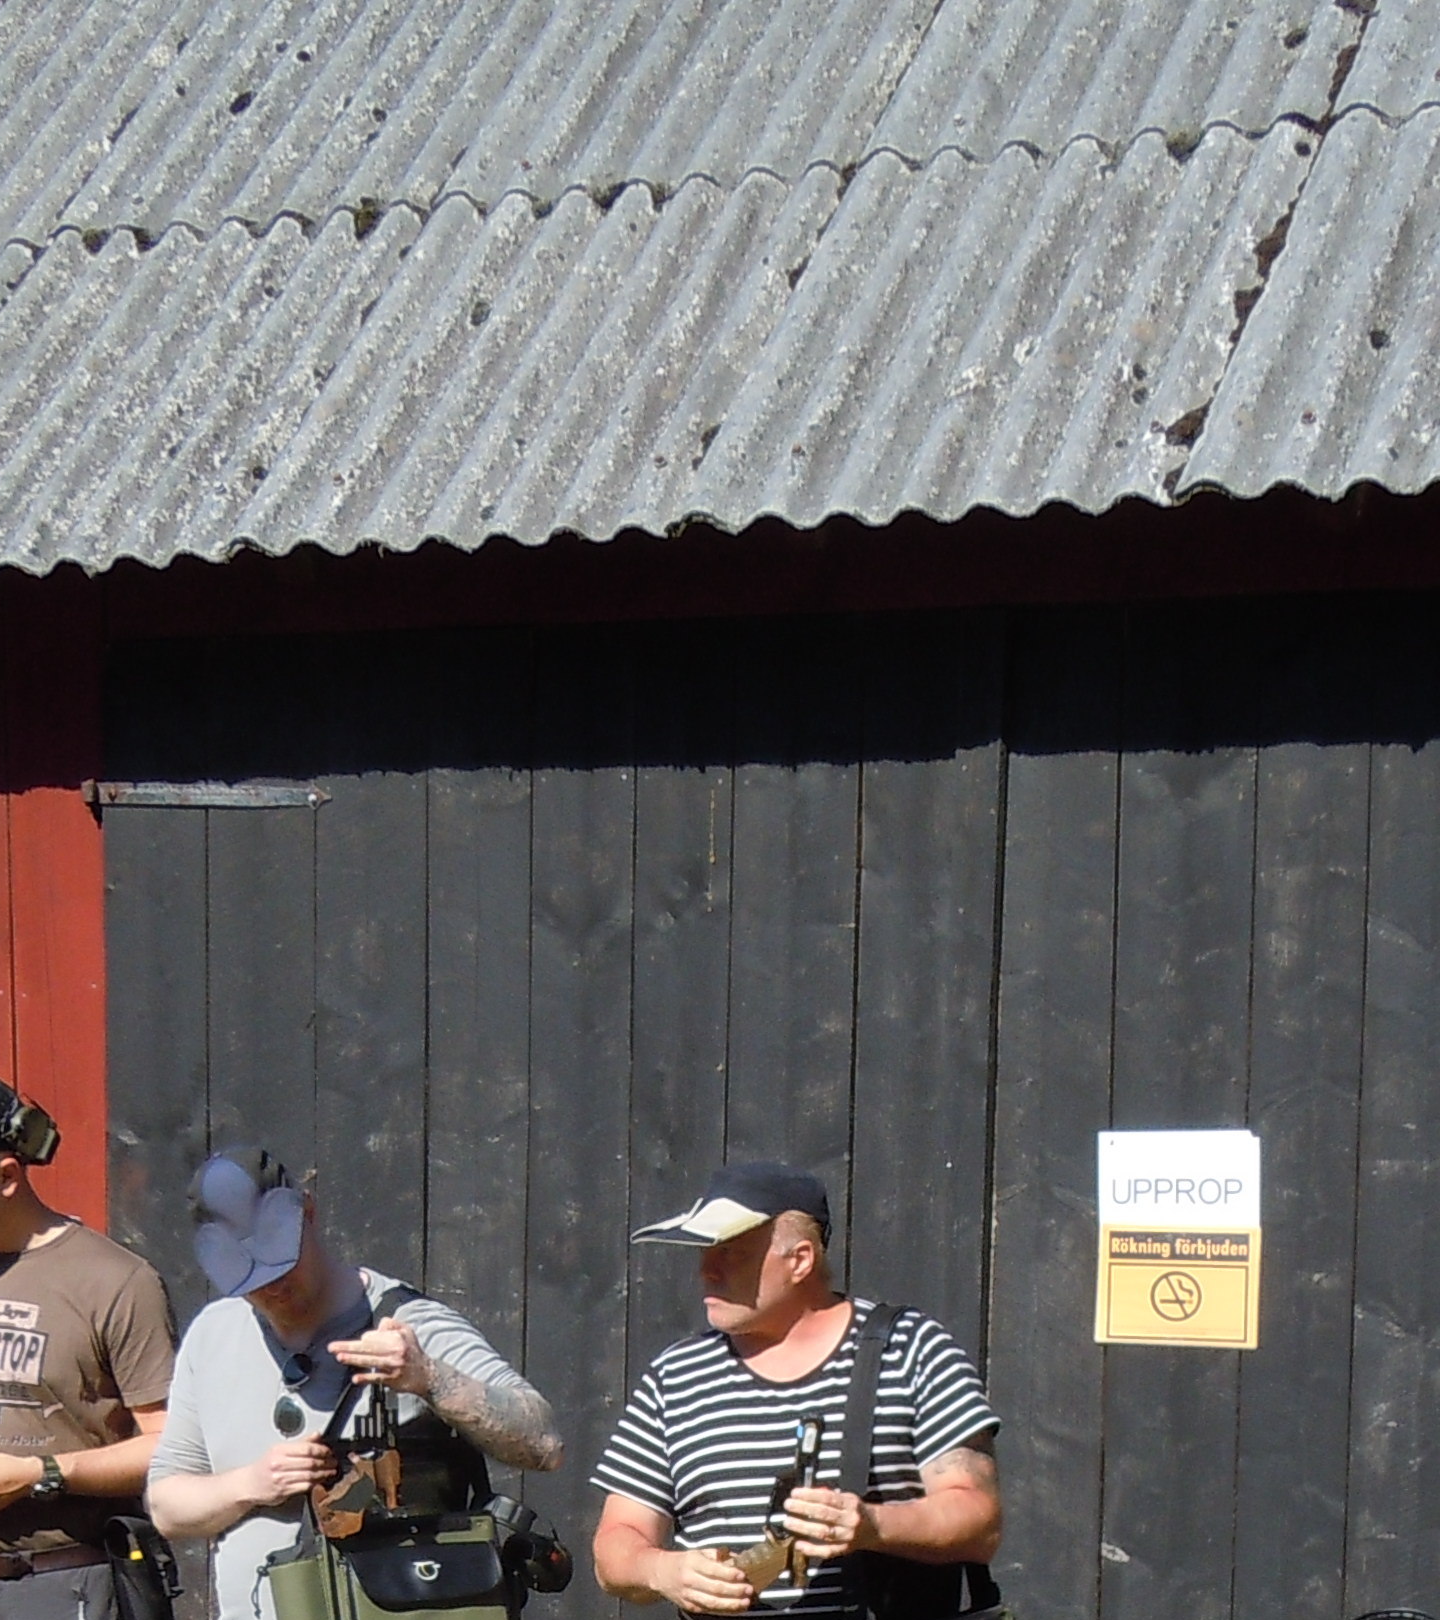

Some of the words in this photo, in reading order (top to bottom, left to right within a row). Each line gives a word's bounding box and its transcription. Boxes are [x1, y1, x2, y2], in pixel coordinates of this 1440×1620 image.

[1112, 1178, 1243, 1204] UPPROP
[1111, 1237, 1171, 1257] Rökning
[1174, 1238, 1248, 1259] förbjuden
